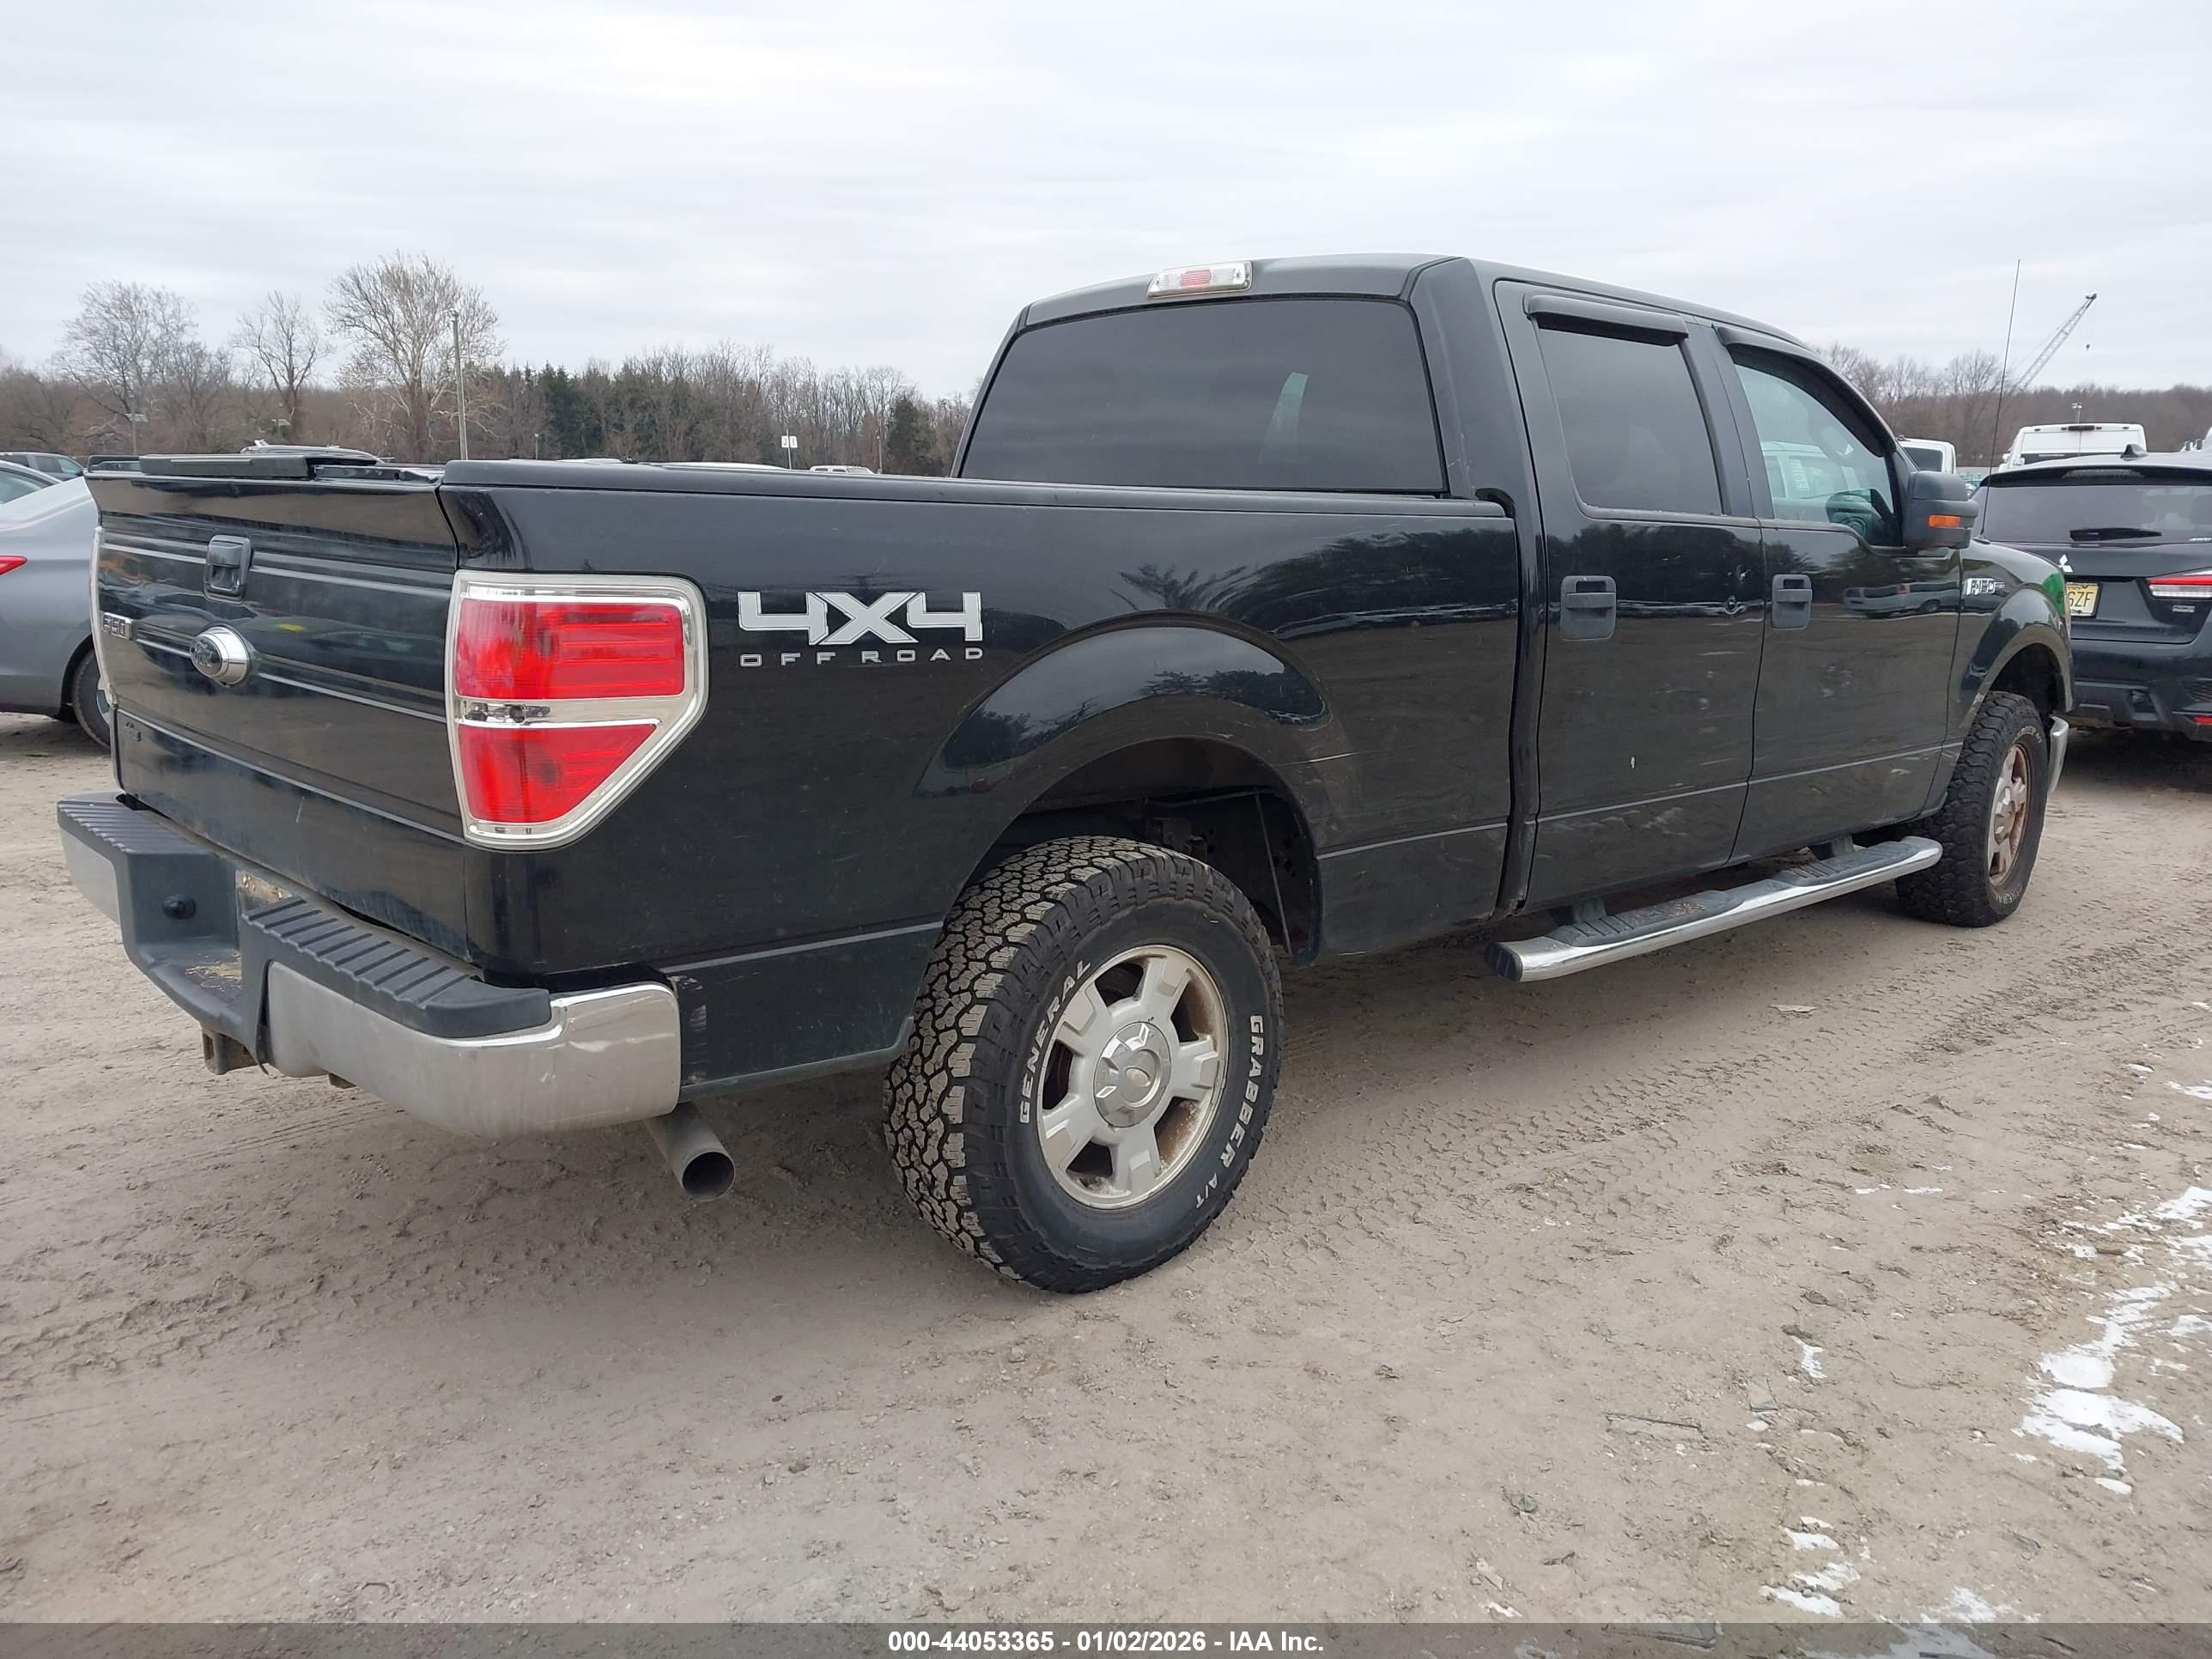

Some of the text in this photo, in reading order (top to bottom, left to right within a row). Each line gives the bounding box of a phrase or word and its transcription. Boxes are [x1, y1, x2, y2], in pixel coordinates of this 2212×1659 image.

[740, 647, 984, 667] OFF ROAD
[1019, 960, 1091, 1124] GENERAL
[1220, 1015, 1264, 1169] GRABBER
